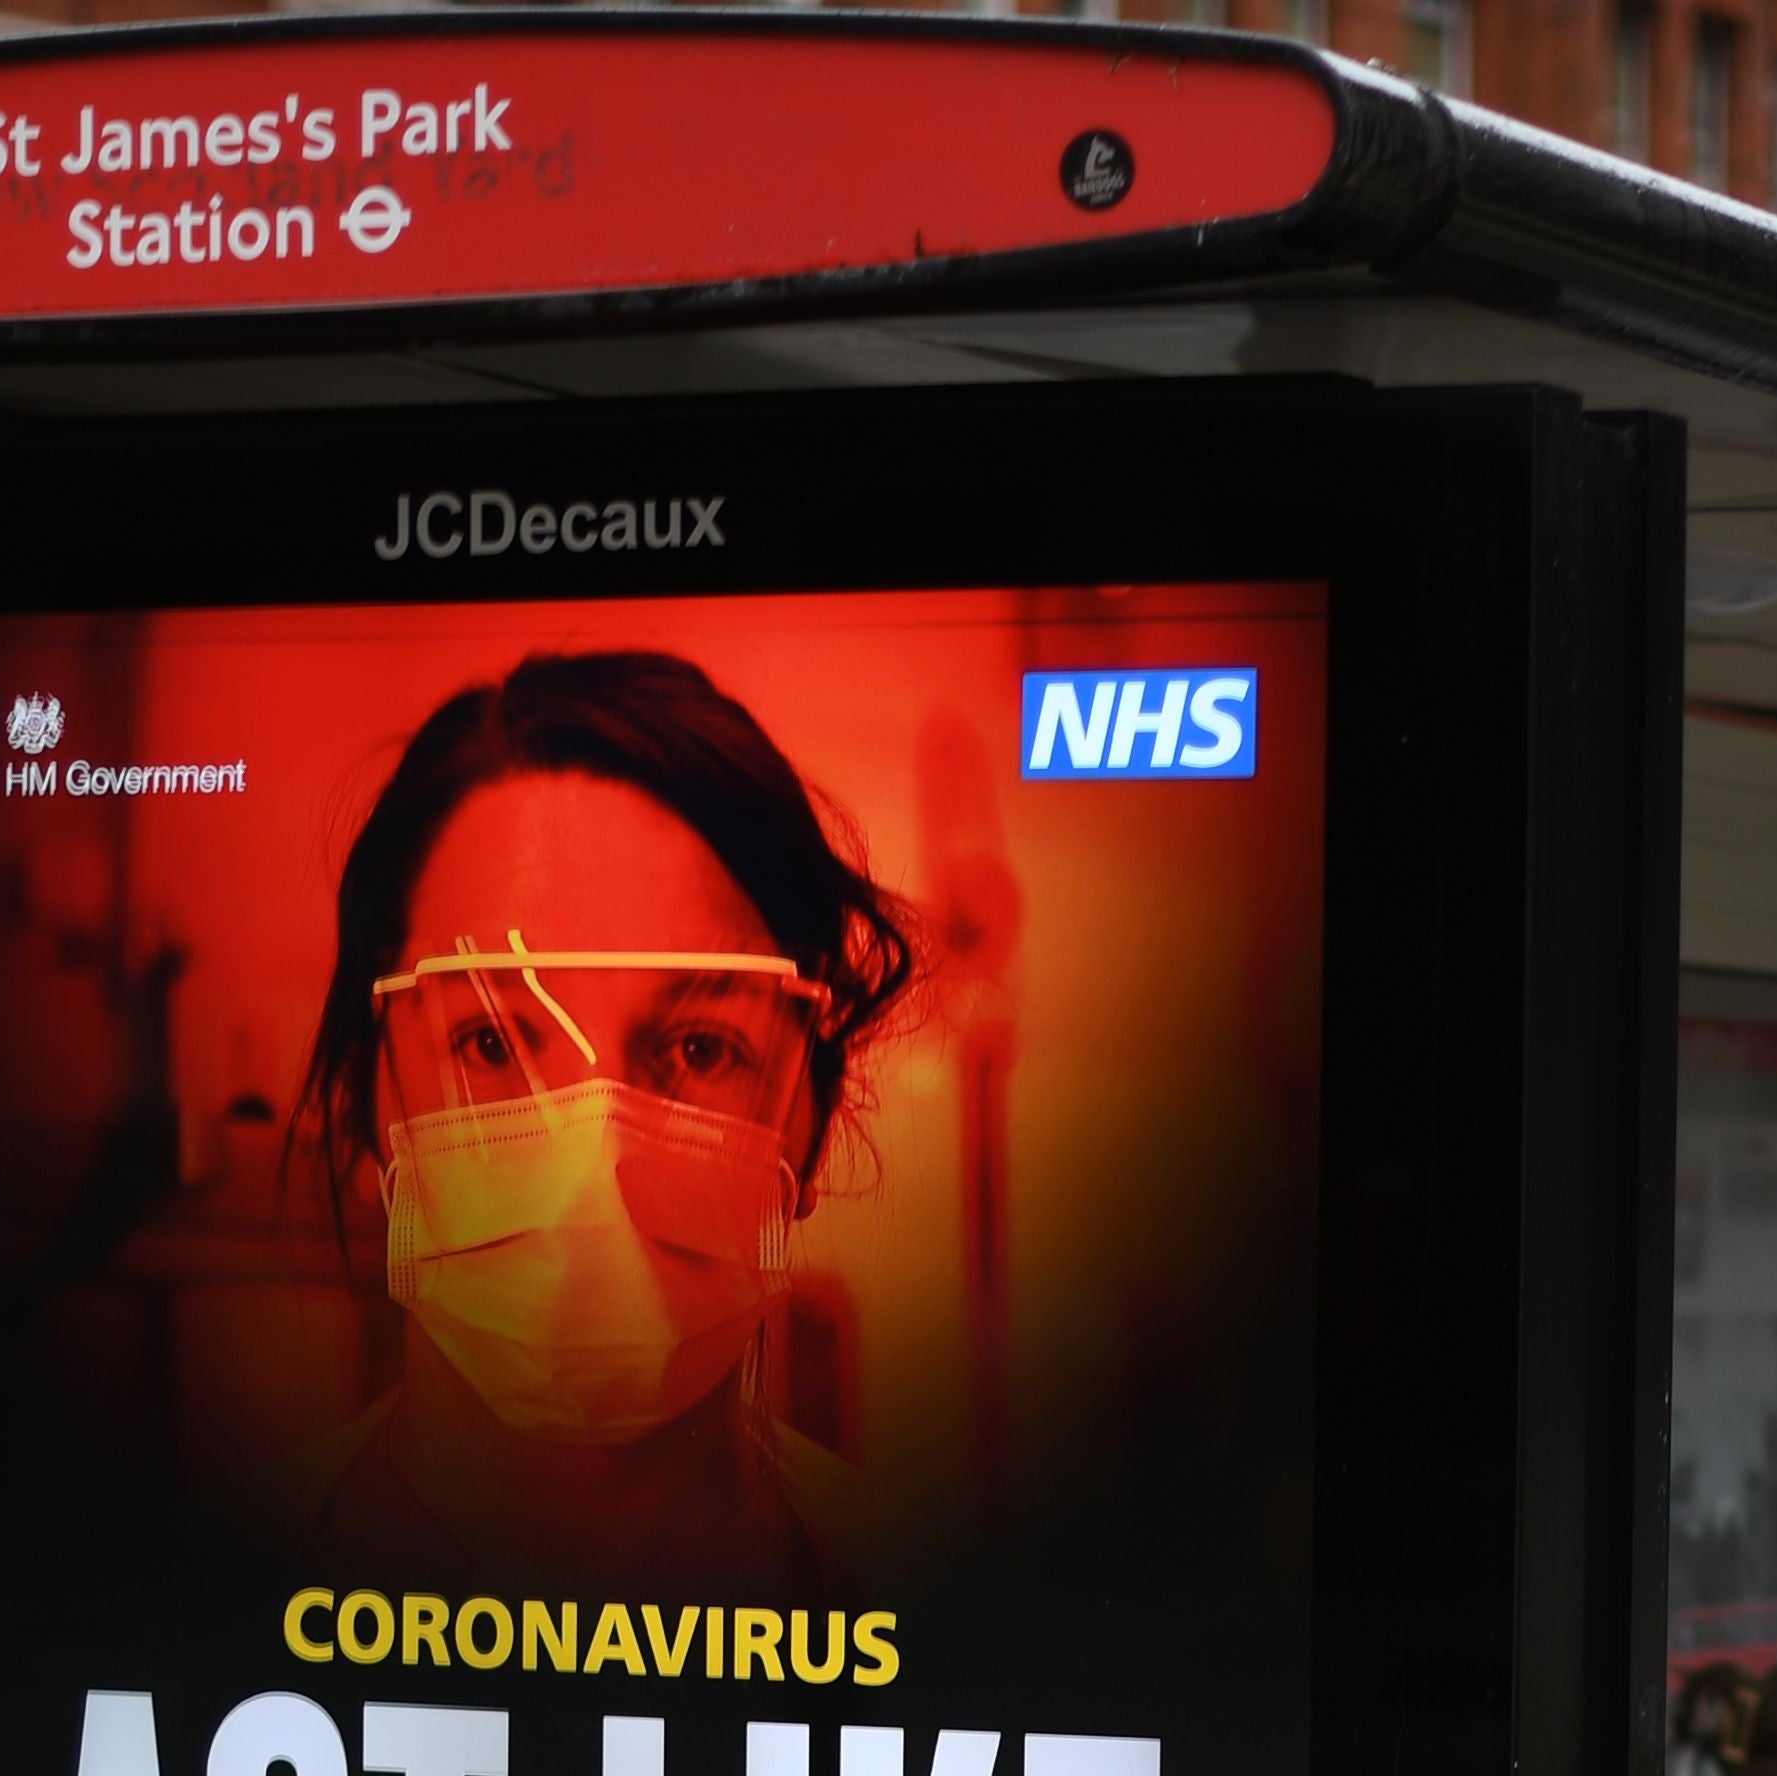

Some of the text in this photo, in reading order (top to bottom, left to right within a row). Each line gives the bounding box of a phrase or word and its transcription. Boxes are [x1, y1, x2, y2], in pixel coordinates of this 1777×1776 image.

[61, 94, 336, 174] James's
[362, 84, 511, 157] Park
[67, 194, 314, 268] Station
[375, 493, 723, 559] JCDecaux
[1030, 678, 1249, 768] NHS
[6, 759, 246, 796] HM Government
[284, 1588, 899, 1686] CORONAVIRUS
